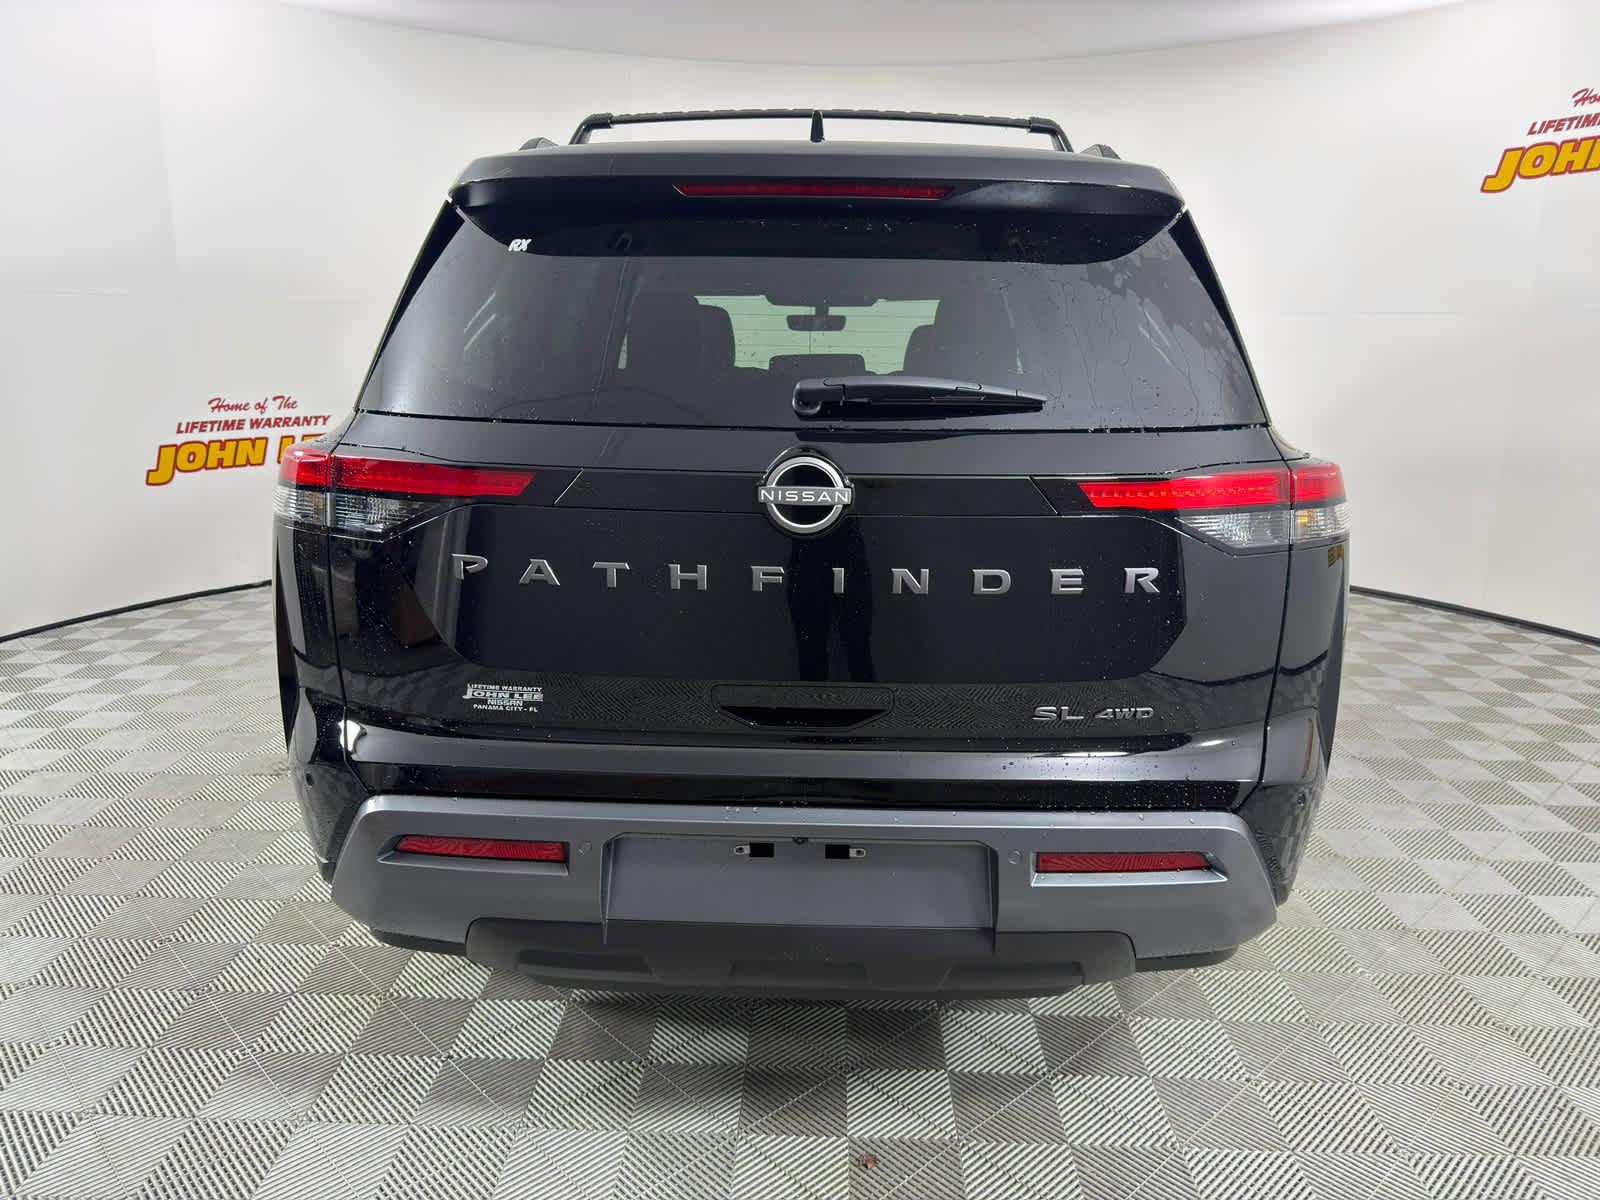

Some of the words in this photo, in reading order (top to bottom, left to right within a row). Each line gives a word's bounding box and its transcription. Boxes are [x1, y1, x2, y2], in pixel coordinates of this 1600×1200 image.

[1572, 88, 1600, 107] Ho
[1527, 112, 1600, 136] LIFETIM
[207, 397, 250, 413] Home
[254, 397, 268, 415] of
[272, 395, 298, 411] The
[176, 418, 246, 434] LIFETIME
[250, 415, 331, 430] WARRANTY
[146, 436, 269, 486] JOHN
[760, 489, 849, 503] NISSAN
[451, 553, 1160, 595] PATHFINDER
[462, 688, 510, 700] JOHN
[473, 703, 504, 711] PANAMA
[1032, 706, 1084, 720] SL
[1095, 707, 1154, 720] 4WD
